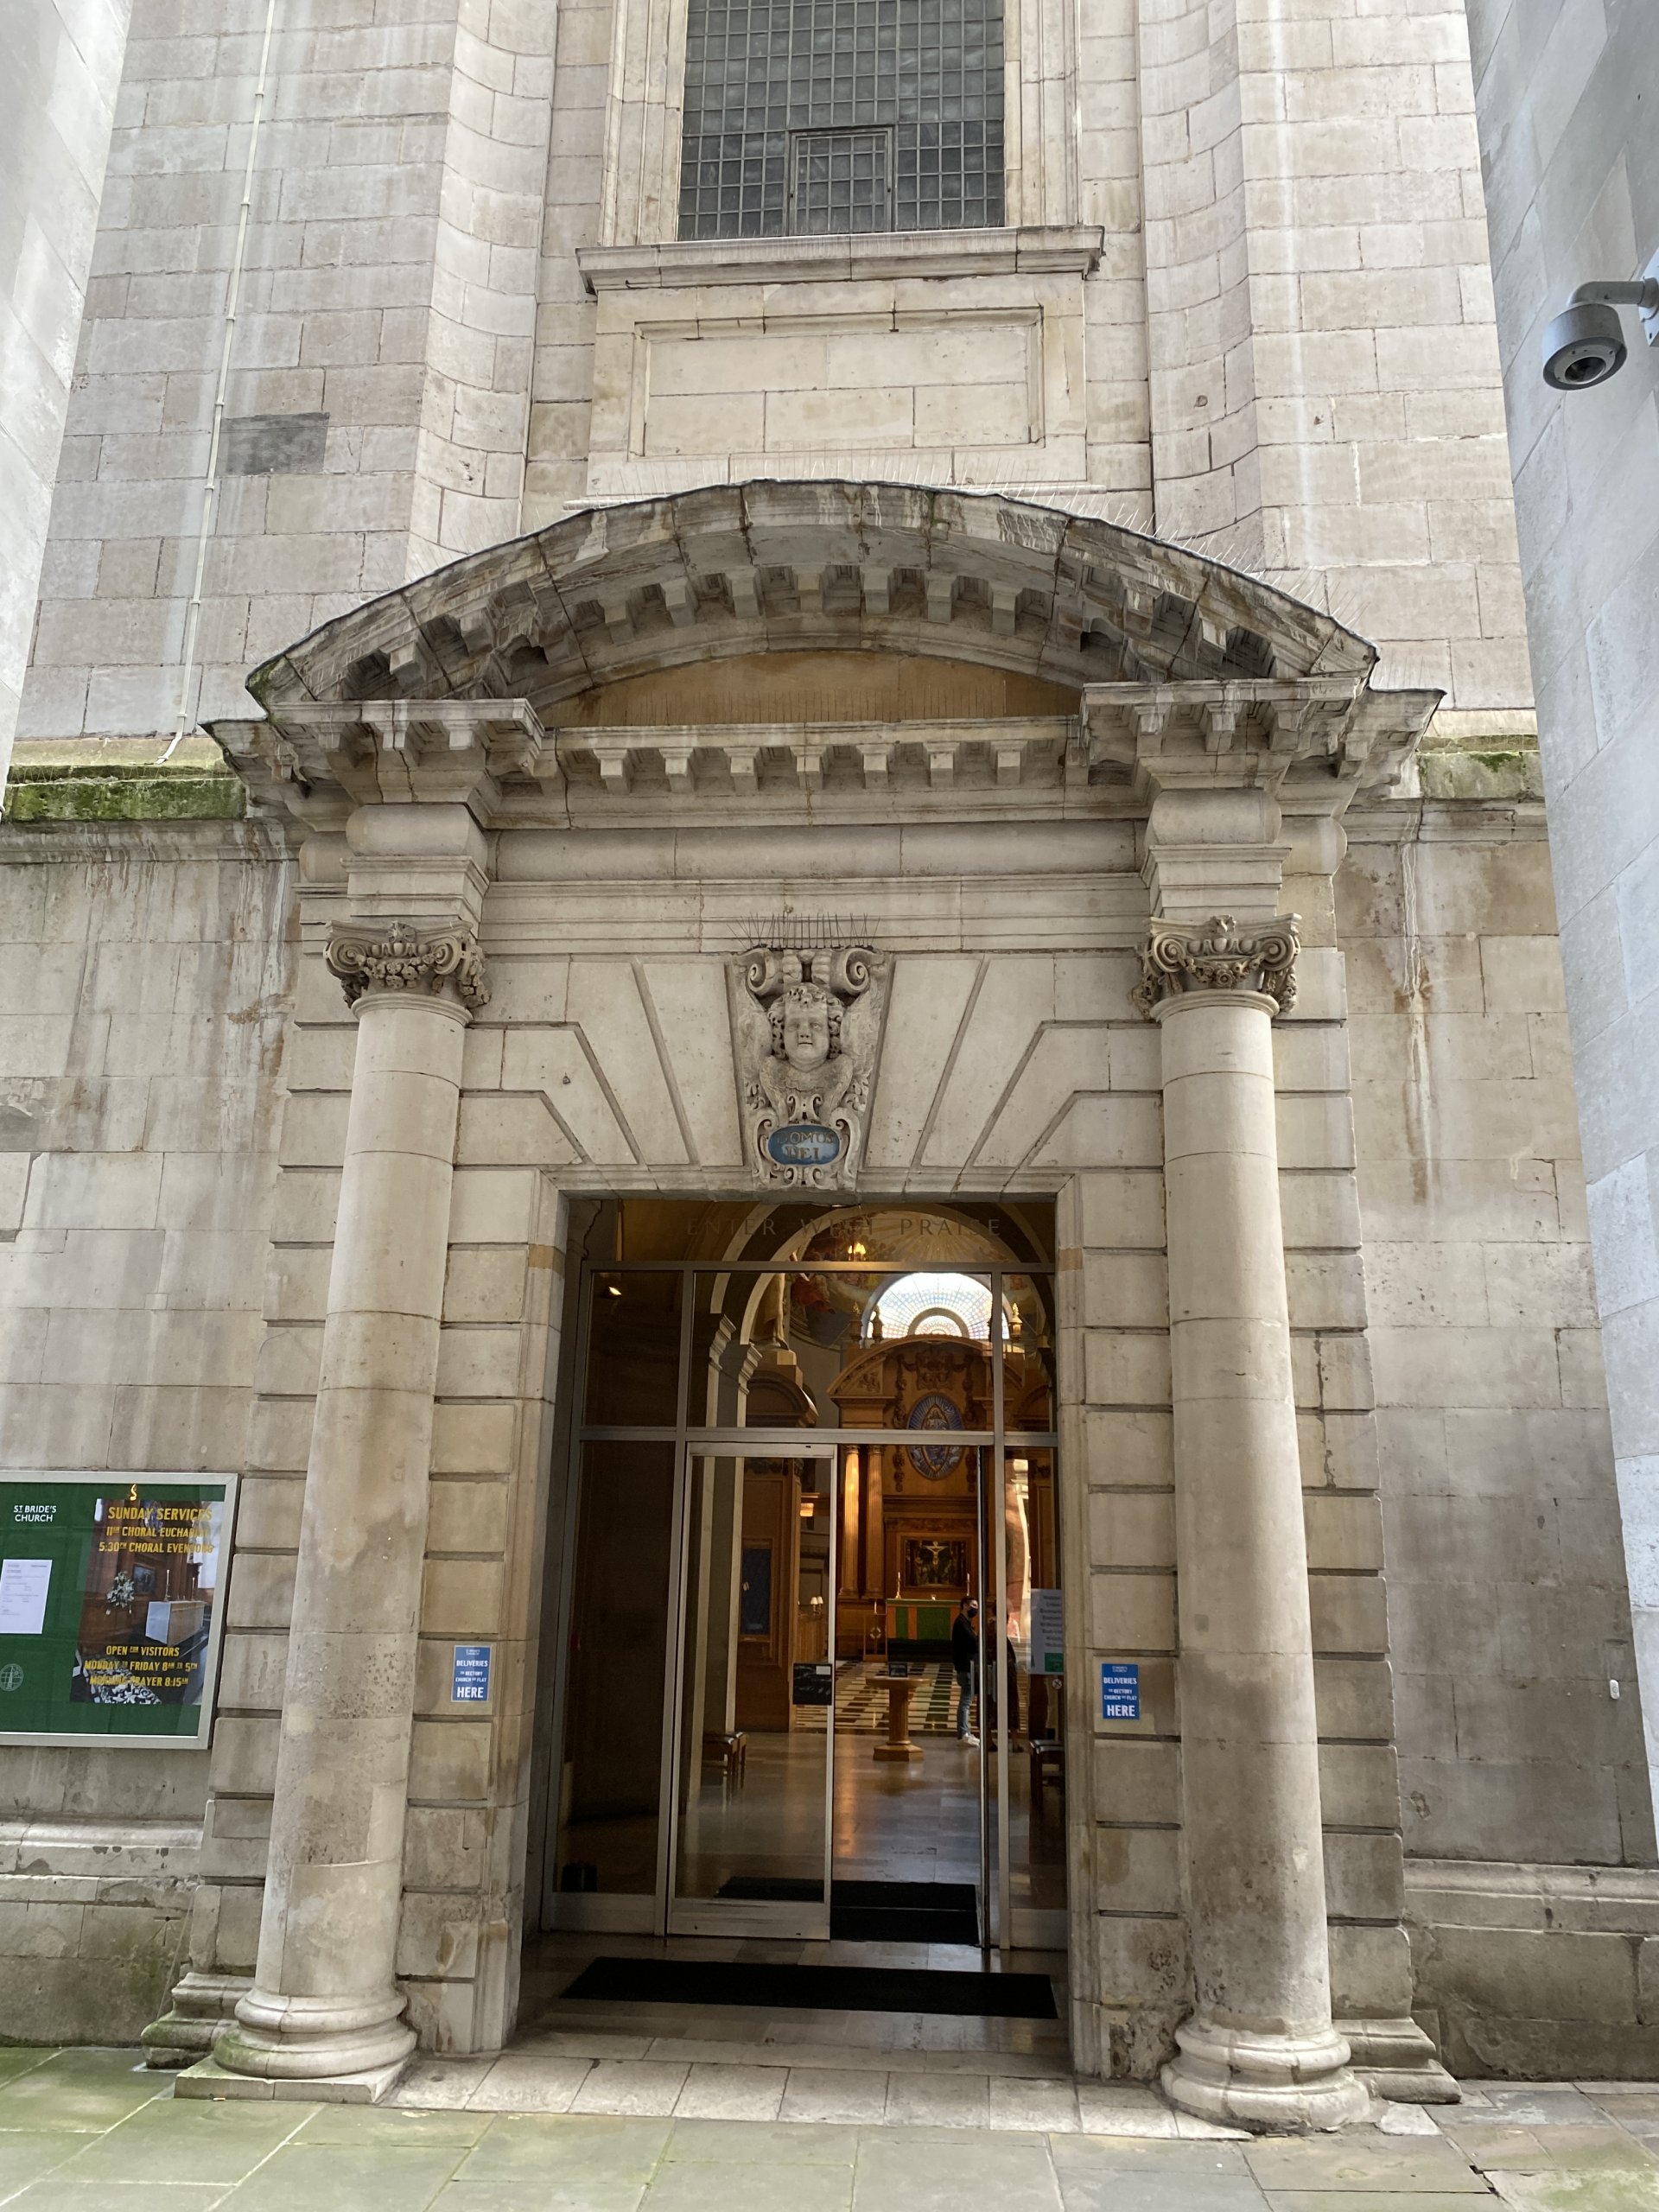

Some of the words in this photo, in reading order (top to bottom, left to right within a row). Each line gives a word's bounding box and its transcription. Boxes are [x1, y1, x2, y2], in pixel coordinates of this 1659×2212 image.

[784, 1146, 820, 1160] DEI
[687, 1217, 777, 1236] ENTER
[24, 1504, 57, 1513] BRIDE'S
[108, 1506, 154, 1521] SUNDAY
[156, 1507, 213, 1522] SERVICES
[15, 1514, 53, 1522] CHURCH
[122, 1526, 157, 1537] CHORAL
[99, 1541, 127, 1552] 5:30PM
[129, 1541, 164, 1553] CHORAL
[105, 1645, 128, 1656] OPEN
[141, 1646, 180, 1657] VISITORS
[84, 1660, 119, 1670] MONDAY
[130, 1661, 160, 1671] FRIDAY
[130, 1675, 162, 1687] PRAYER
[1103, 1676, 1137, 1685] DELIVERIES
[456, 1687, 484, 1698] HERE
[1107, 1704, 1135, 1717] HERE
